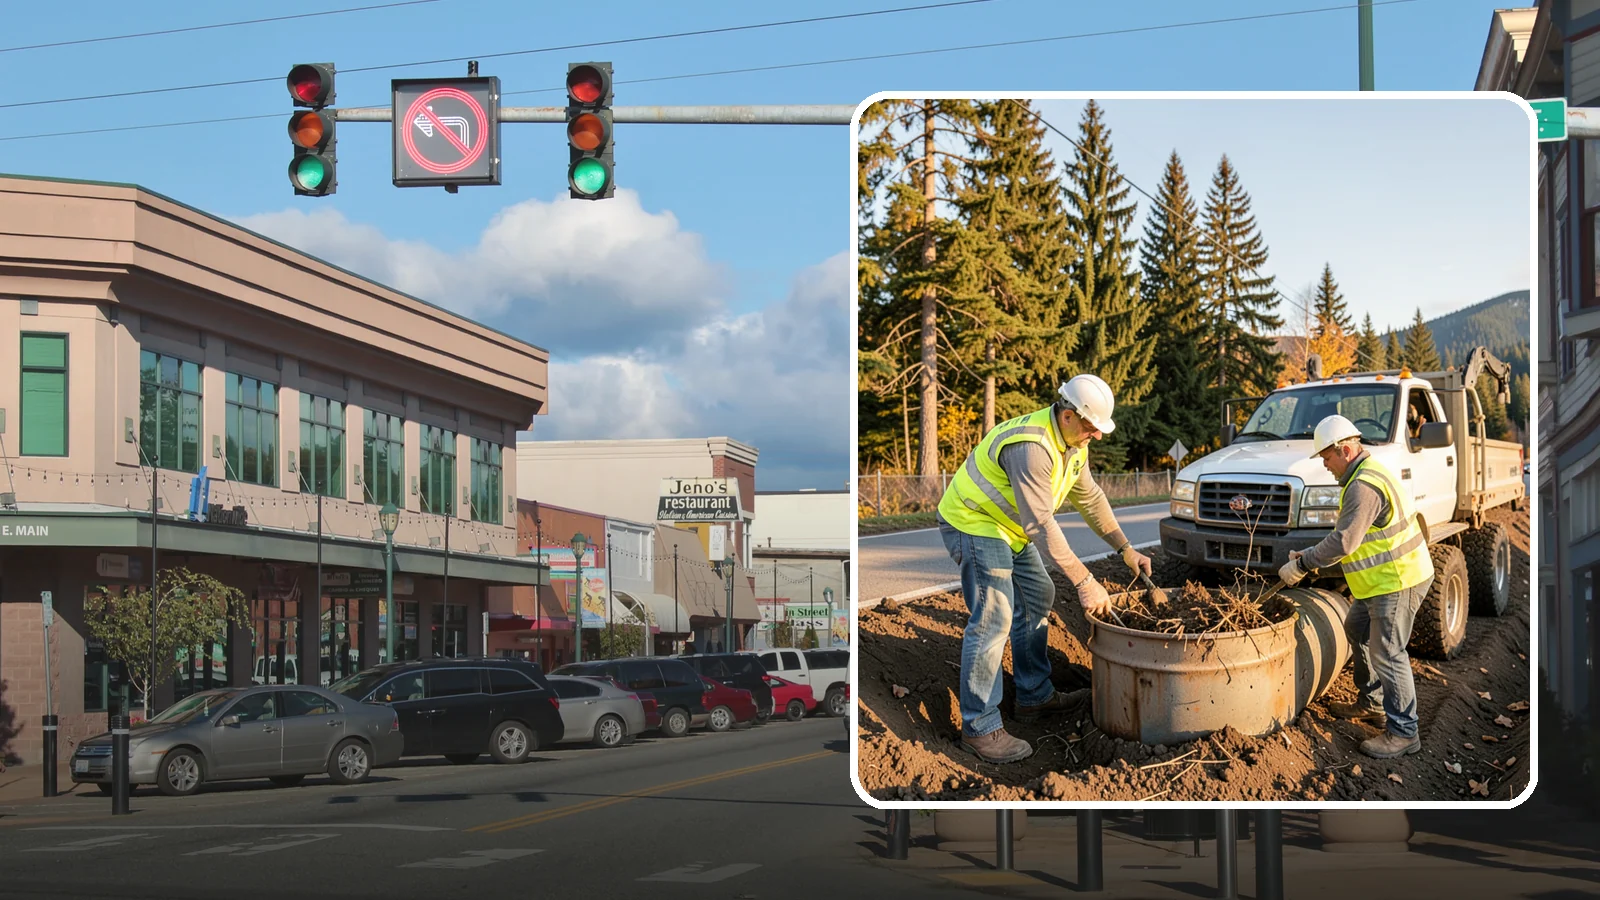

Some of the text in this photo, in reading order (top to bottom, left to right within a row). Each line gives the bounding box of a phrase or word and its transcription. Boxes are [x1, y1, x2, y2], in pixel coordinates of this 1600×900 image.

[670, 480, 727, 494] Jeno's
[665, 496, 731, 508] restaurant
[659, 510, 682, 519] Italian
[686, 509, 715, 519] American
[715, 509, 737, 519] Cuisine
[2, 525, 49, 536] E. MAIN
[797, 607, 828, 616] Street
[791, 619, 824, 627] lass
